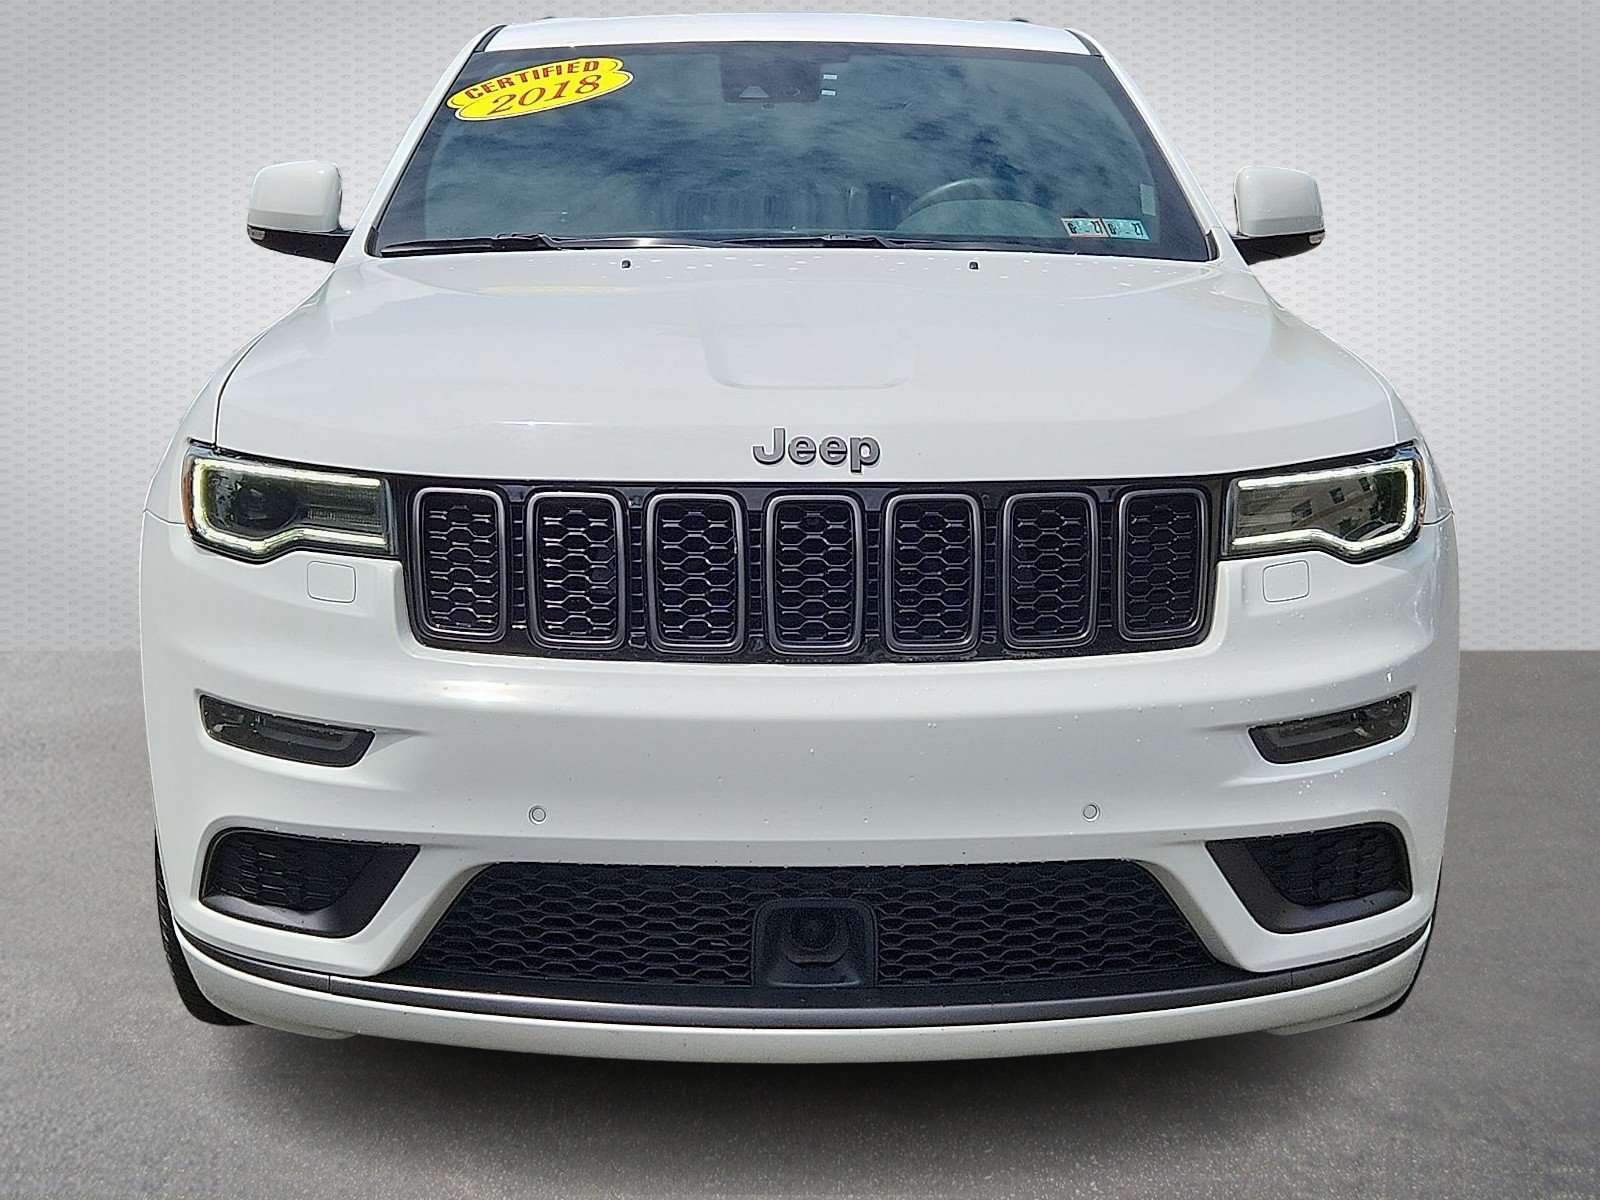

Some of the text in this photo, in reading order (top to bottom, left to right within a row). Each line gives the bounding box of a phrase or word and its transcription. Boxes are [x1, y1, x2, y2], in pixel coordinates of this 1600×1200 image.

[465, 60, 600, 99] CERTIFIED
[487, 74, 602, 116] 2018
[752, 427, 881, 473] Jeep
